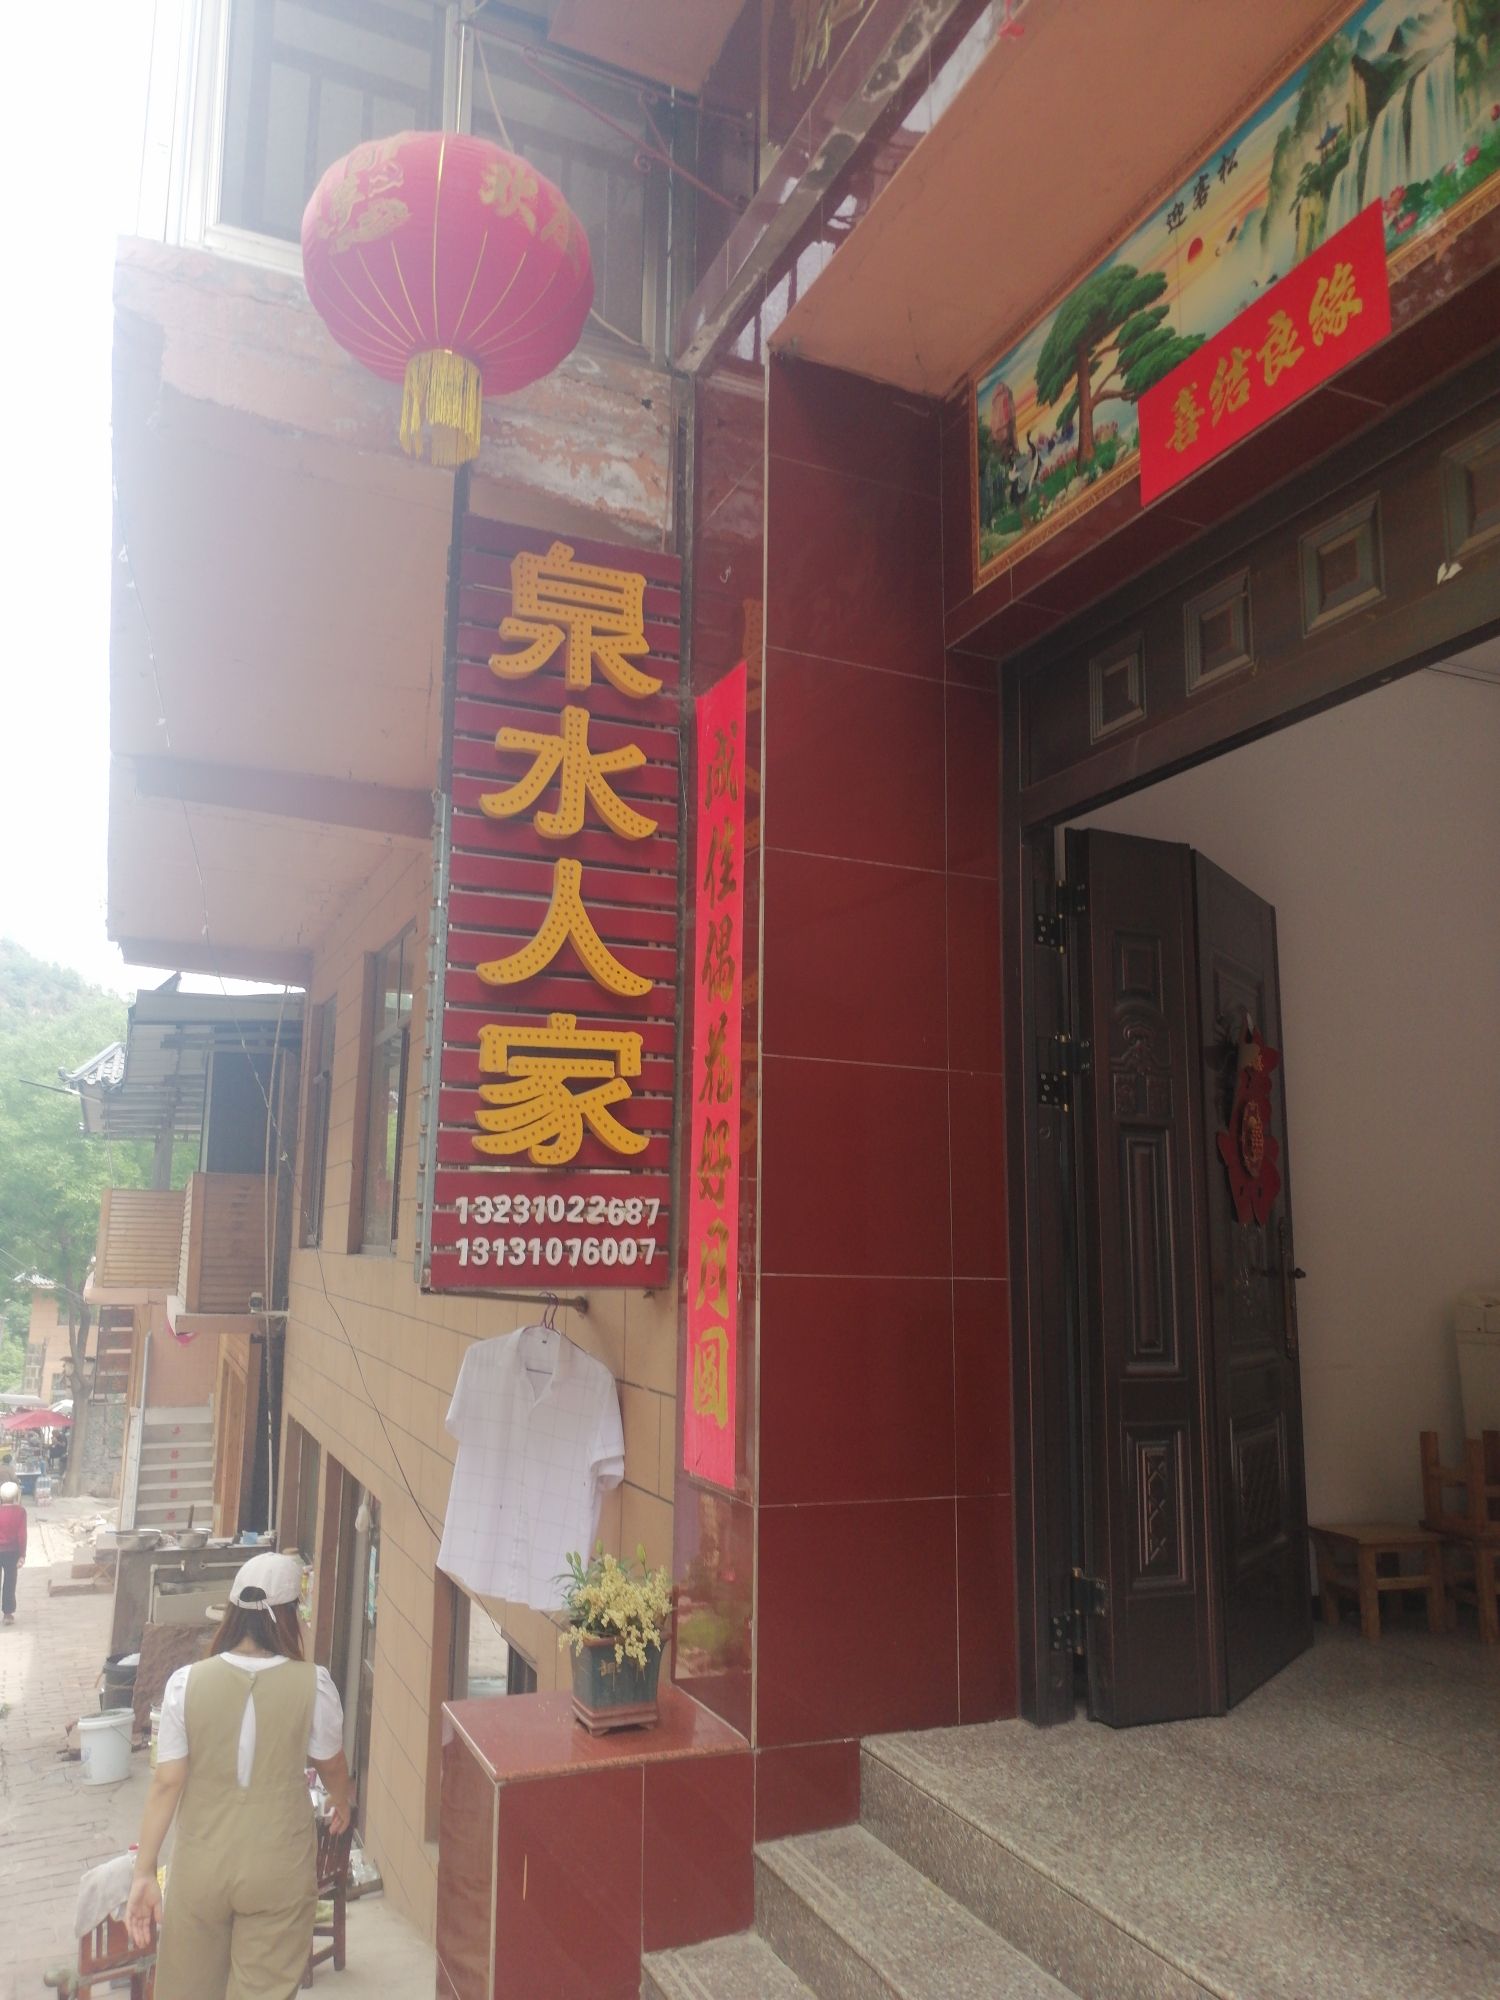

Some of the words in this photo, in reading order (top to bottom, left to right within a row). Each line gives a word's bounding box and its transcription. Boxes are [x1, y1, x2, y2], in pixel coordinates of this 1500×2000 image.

[472, 541, 663, 1166] 泉水人家
[455, 1194, 661, 1228] 13231022687
[455, 1236, 656, 1267] 13131076007
